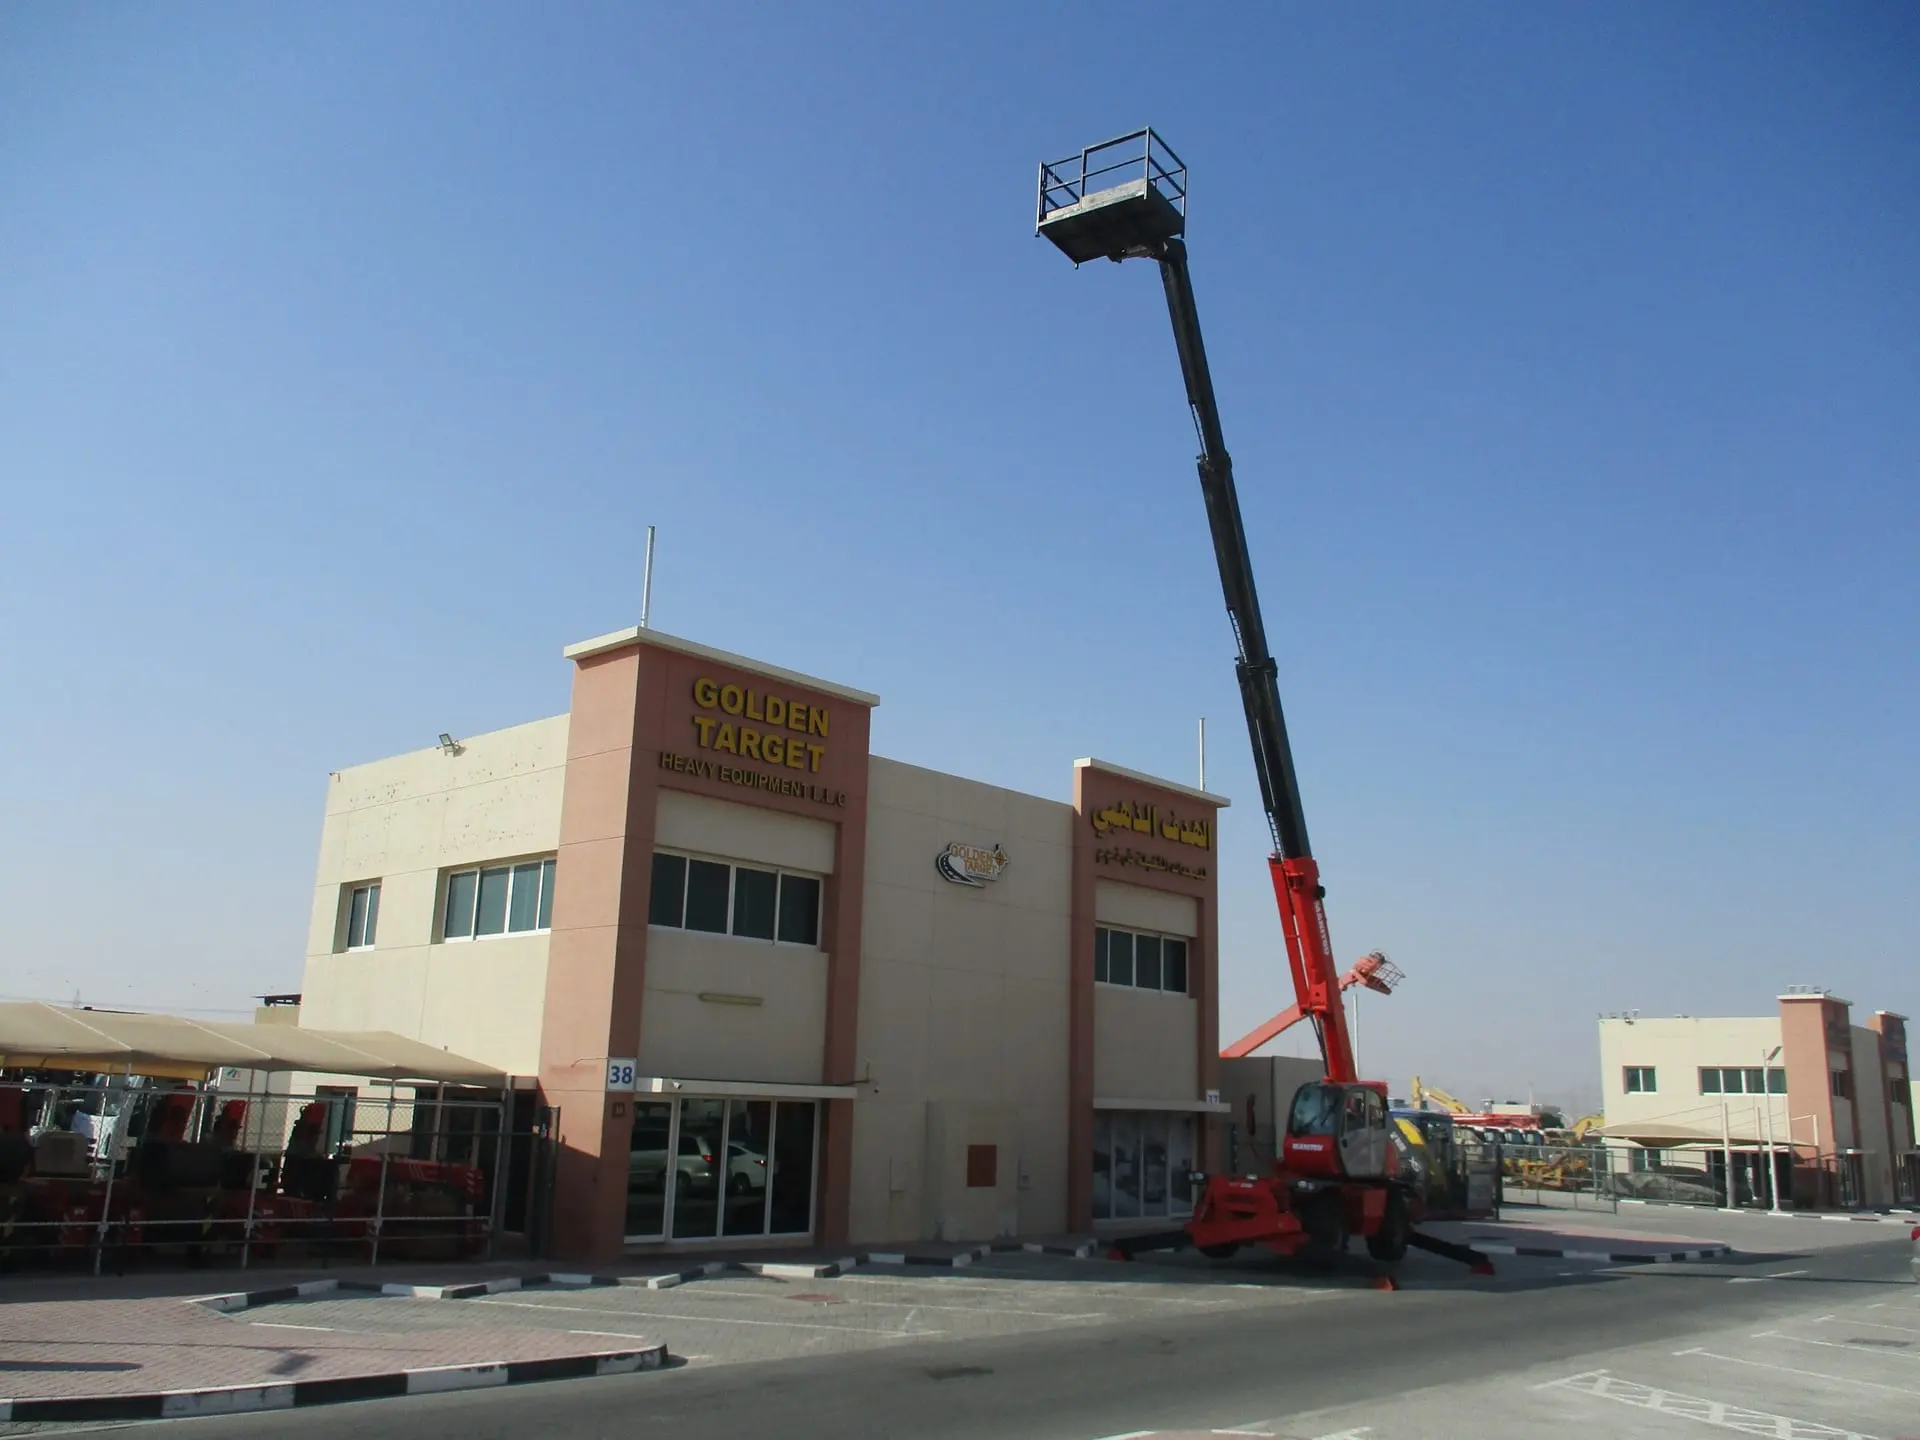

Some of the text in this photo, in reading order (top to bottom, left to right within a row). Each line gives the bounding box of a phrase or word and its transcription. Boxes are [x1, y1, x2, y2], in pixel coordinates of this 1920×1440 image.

[693, 677, 830, 738] GOLDEN
[693, 716, 826, 773] TARGET
[660, 751, 717, 778] HEAVY
[720, 766, 808, 799] EQUIPMENT
[1091, 800, 1212, 850] الهدف الذهبي
[951, 845, 994, 864] GOLDEN
[609, 1065, 633, 1085] 38
